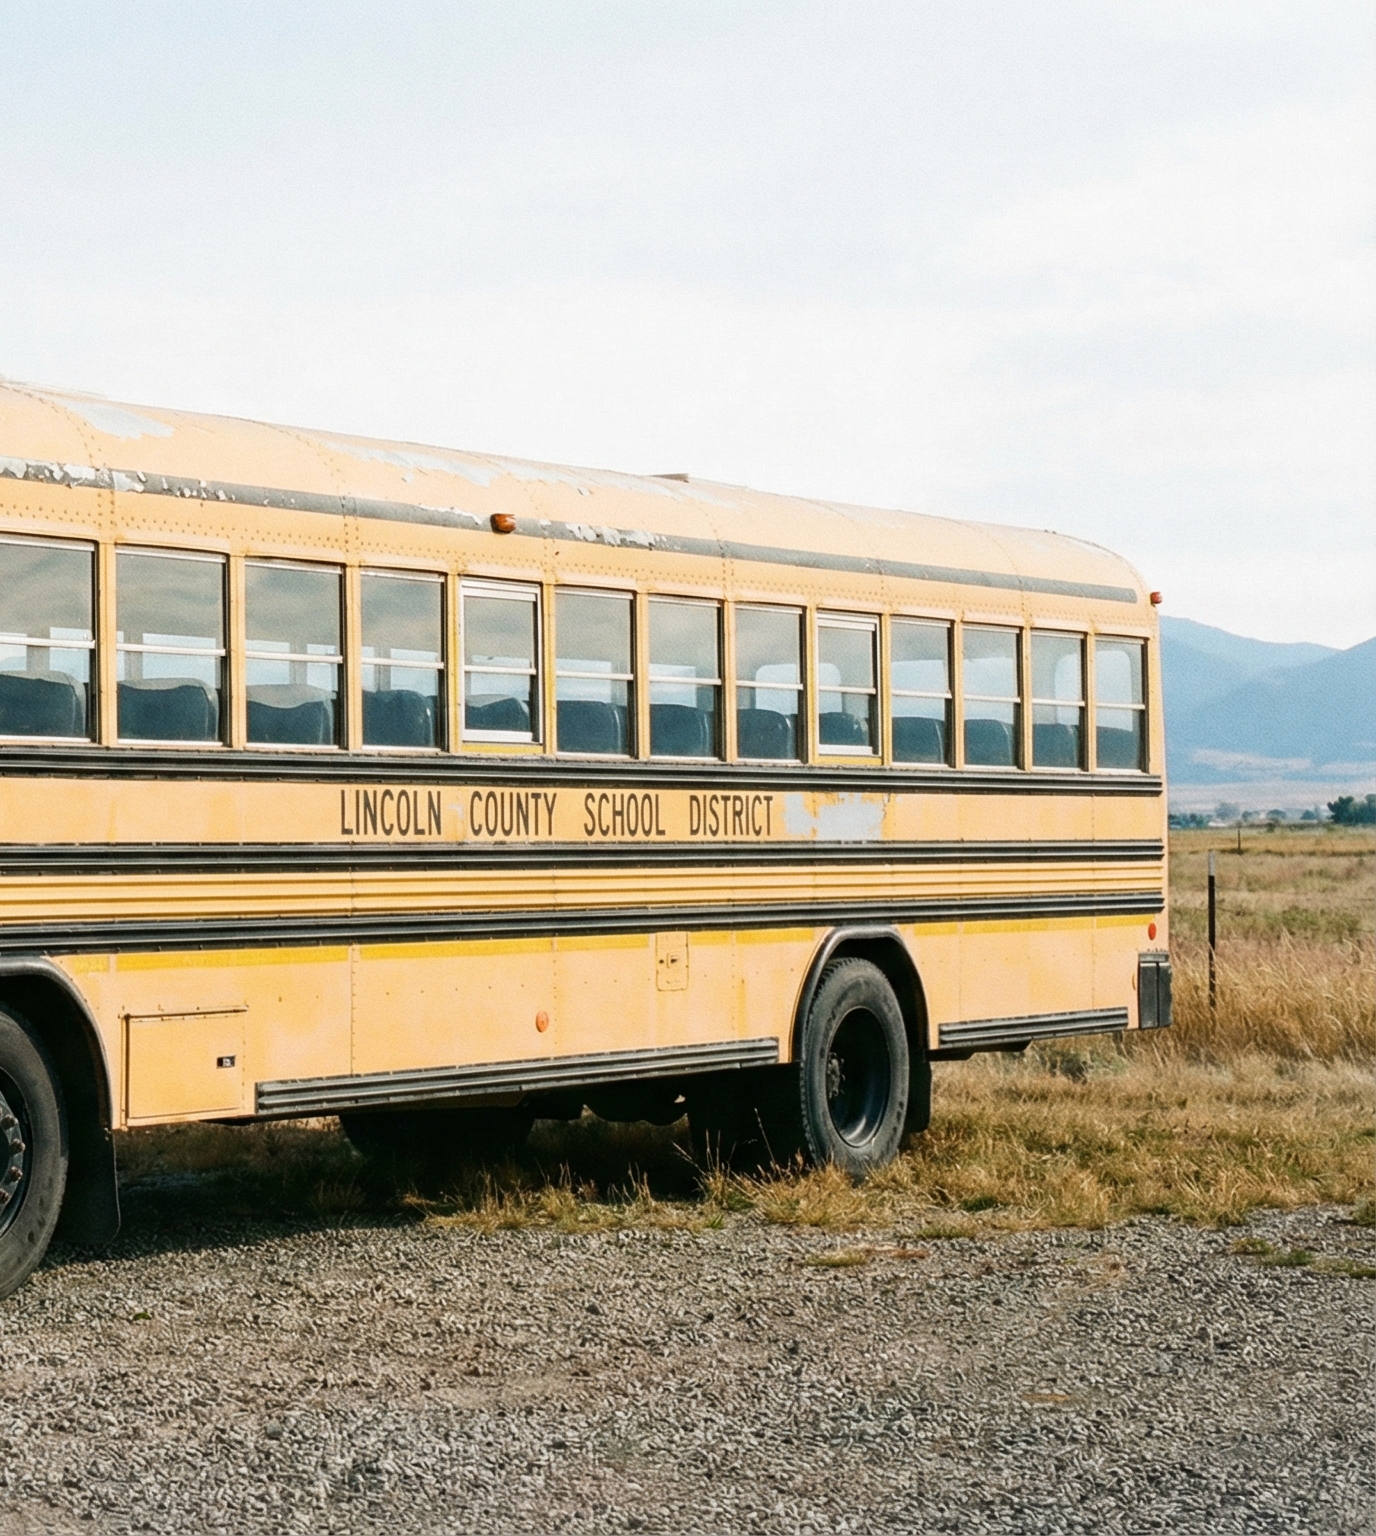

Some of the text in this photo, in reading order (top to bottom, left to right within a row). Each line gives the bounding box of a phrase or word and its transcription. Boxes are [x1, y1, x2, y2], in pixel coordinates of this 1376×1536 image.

[340, 788, 774, 837] LINCOLN COUNTY SCHOOL DISTRICT
